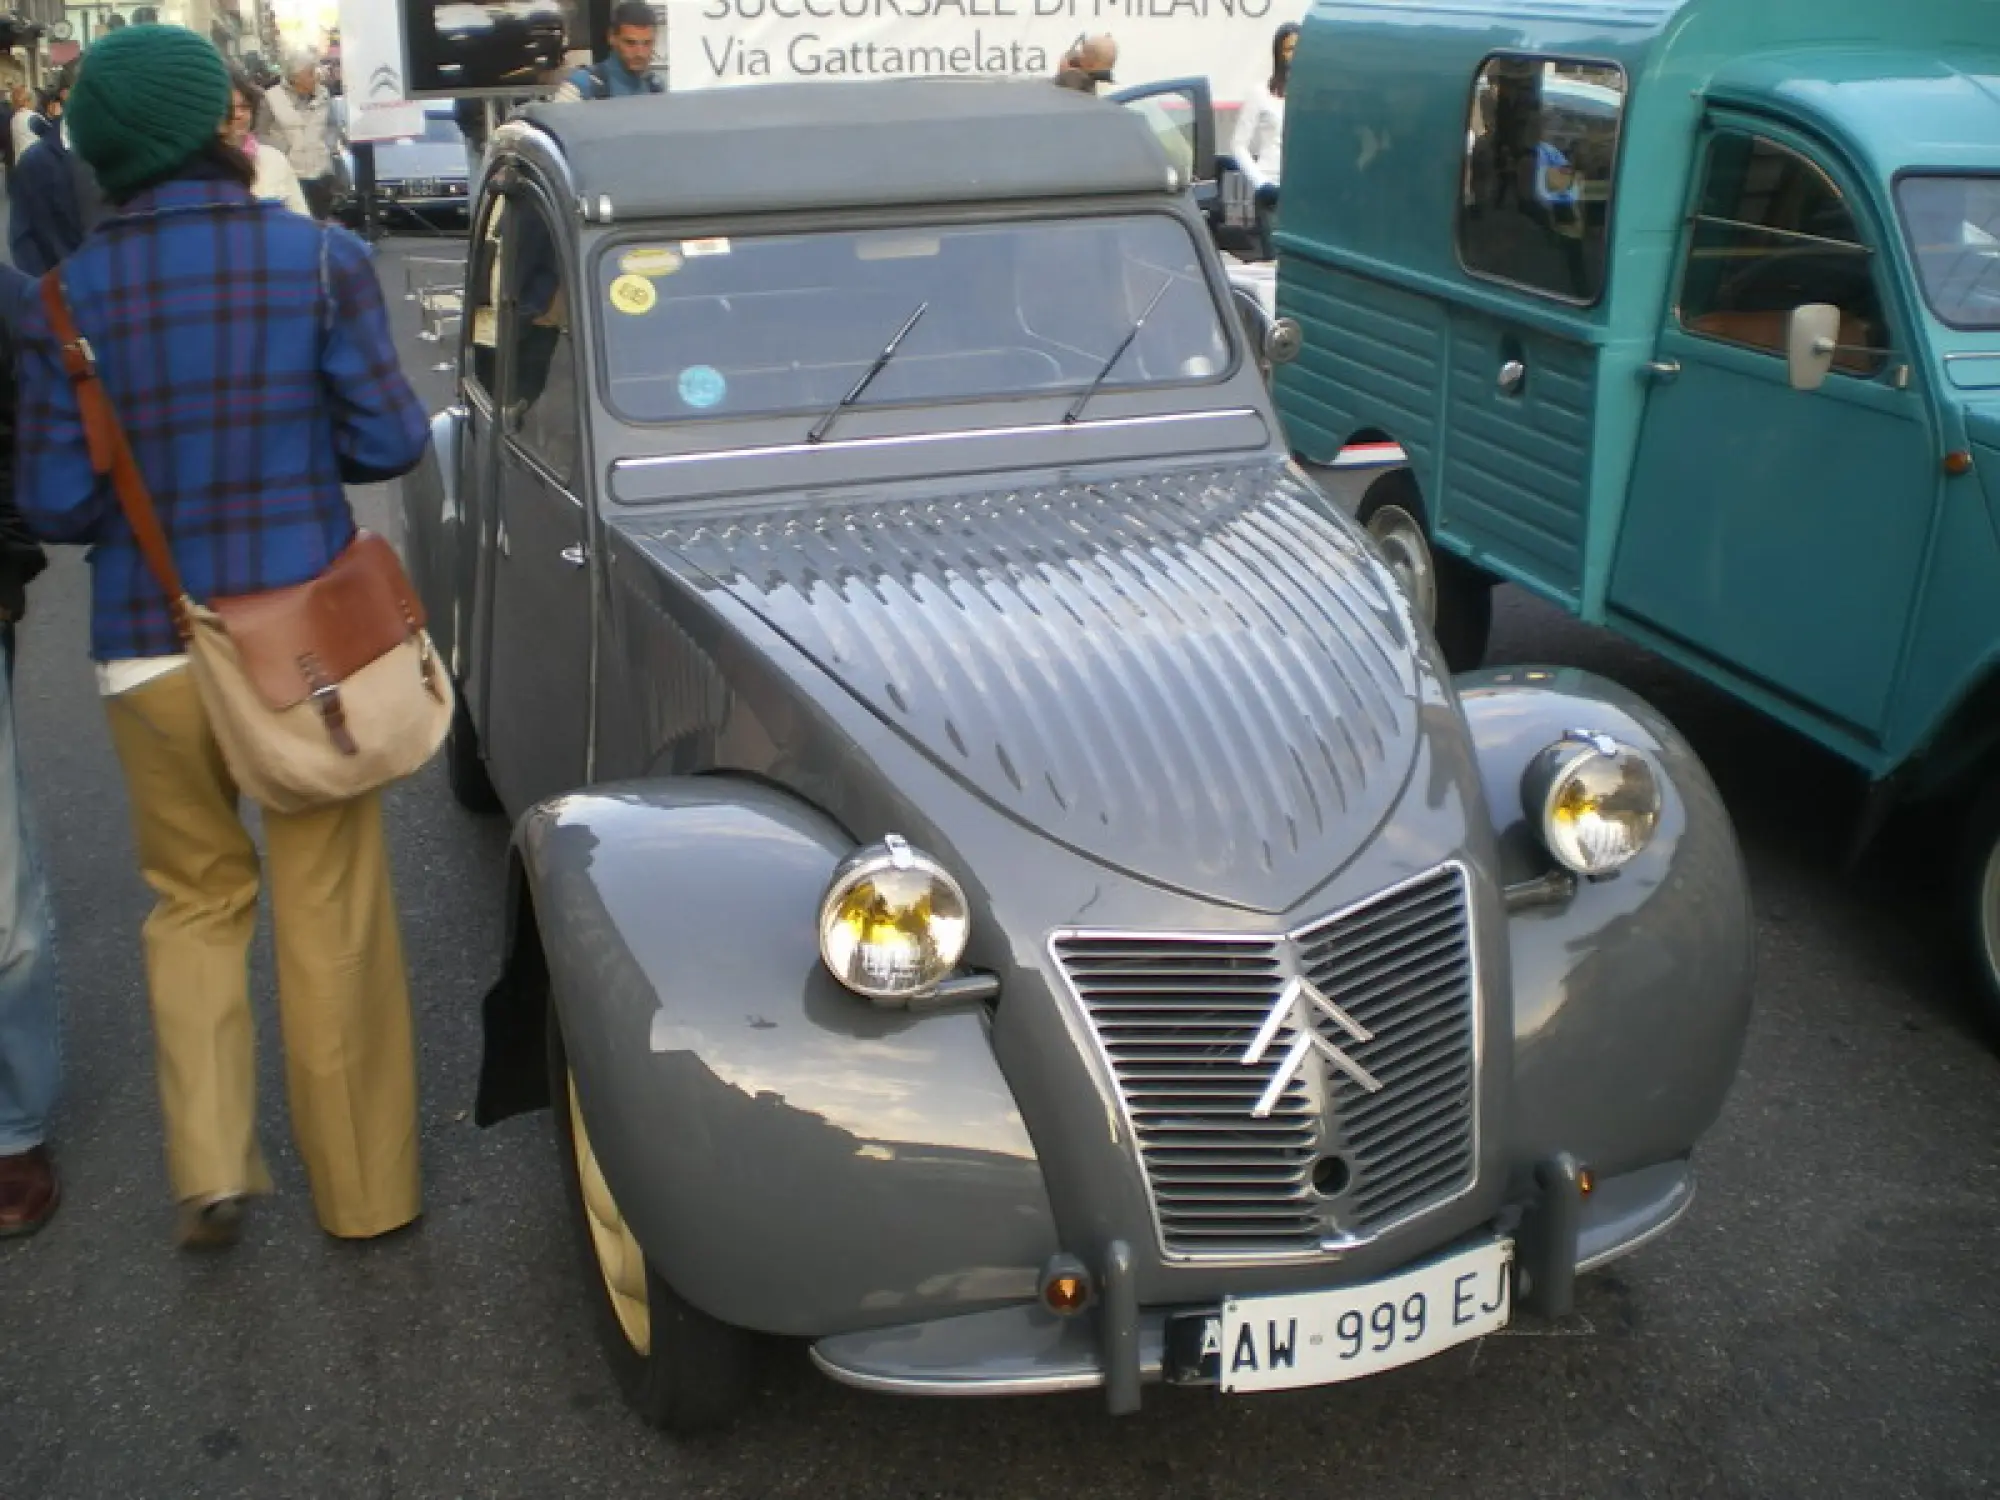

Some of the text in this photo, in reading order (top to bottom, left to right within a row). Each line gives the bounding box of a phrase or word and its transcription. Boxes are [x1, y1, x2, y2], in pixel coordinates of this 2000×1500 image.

[701, 35, 771, 76] Via
[787, 28, 1047, 75] Gattamelata
[1230, 1261, 1507, 1373] AW 999 EJ
